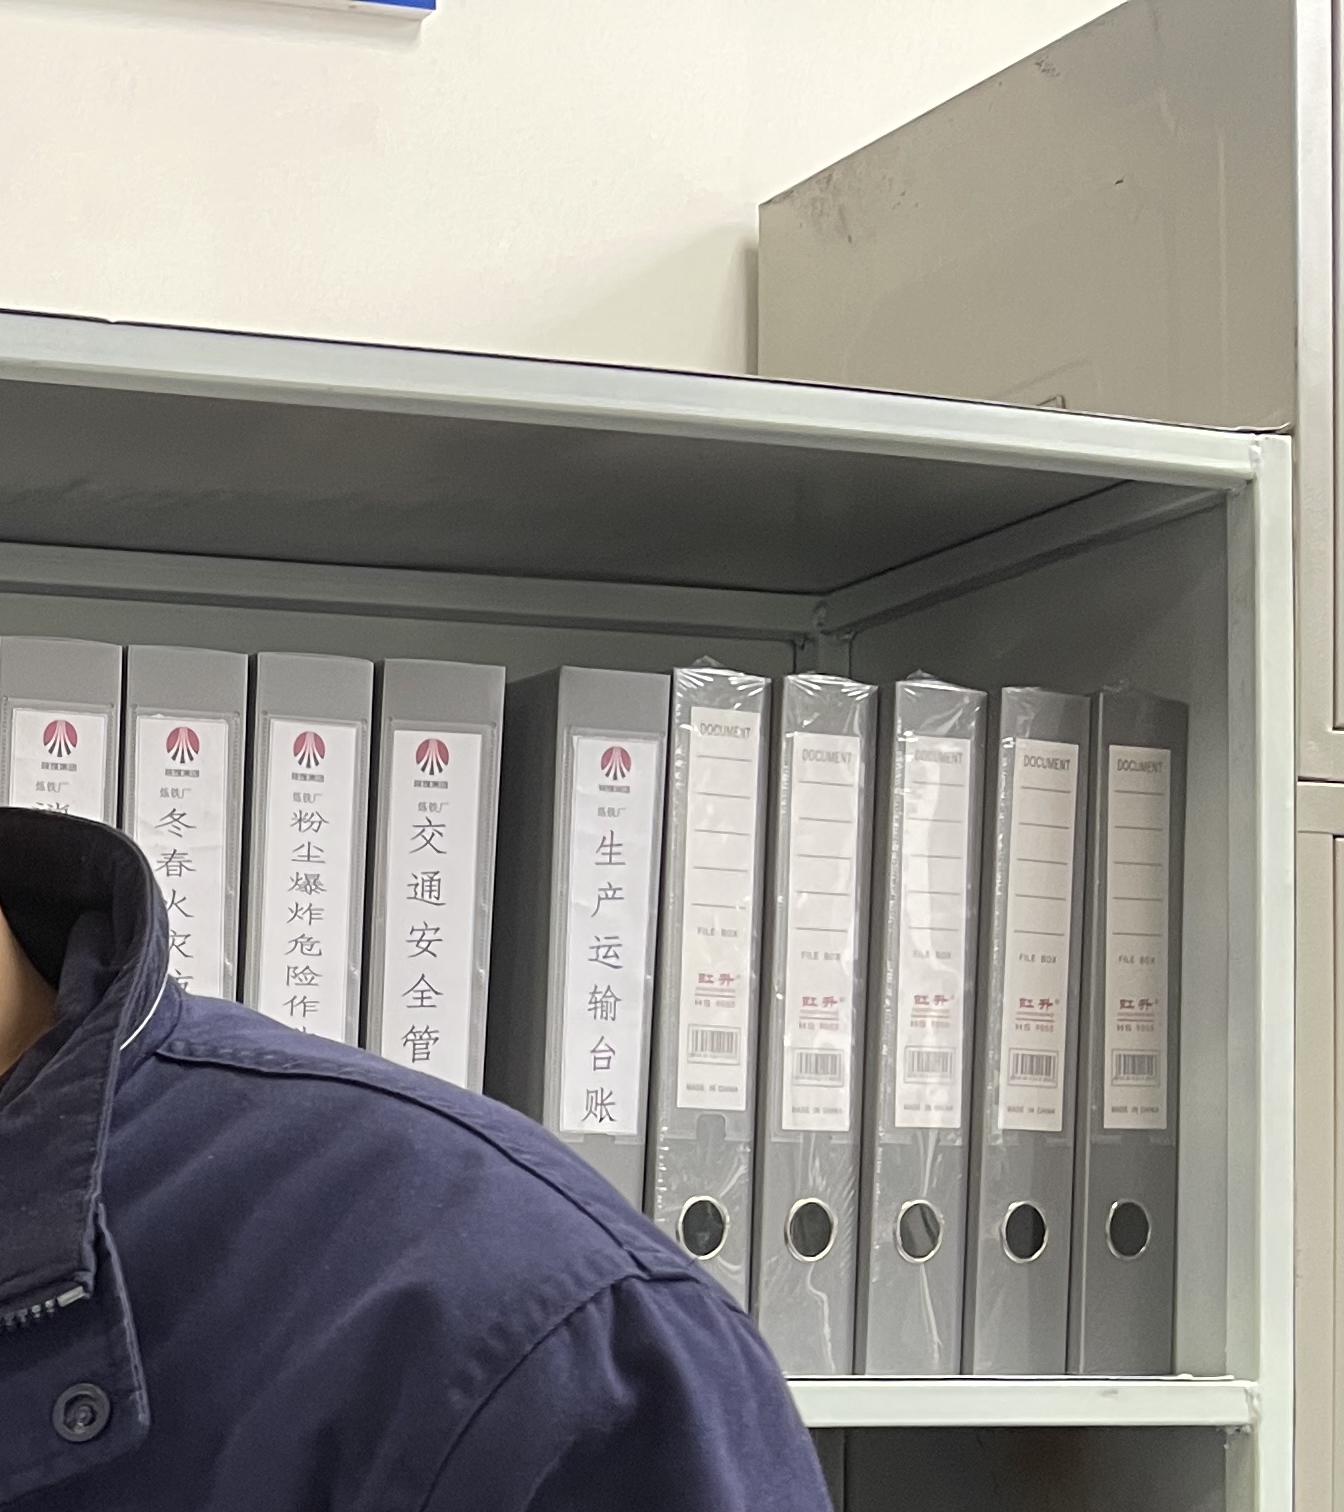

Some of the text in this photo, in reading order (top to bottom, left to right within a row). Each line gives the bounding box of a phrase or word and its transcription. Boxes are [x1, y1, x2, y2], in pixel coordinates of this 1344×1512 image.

[700, 722, 750, 739] DOCUMENT
[801, 748, 852, 764] DOCUMENT
[1023, 754, 1070, 771] DOCUMENT
[1116, 758, 1163, 774] DOCUMENT
[283, 809, 329, 1034] 粉尘爆炸危险作
[581, 830, 627, 1124] 生产运输台账
